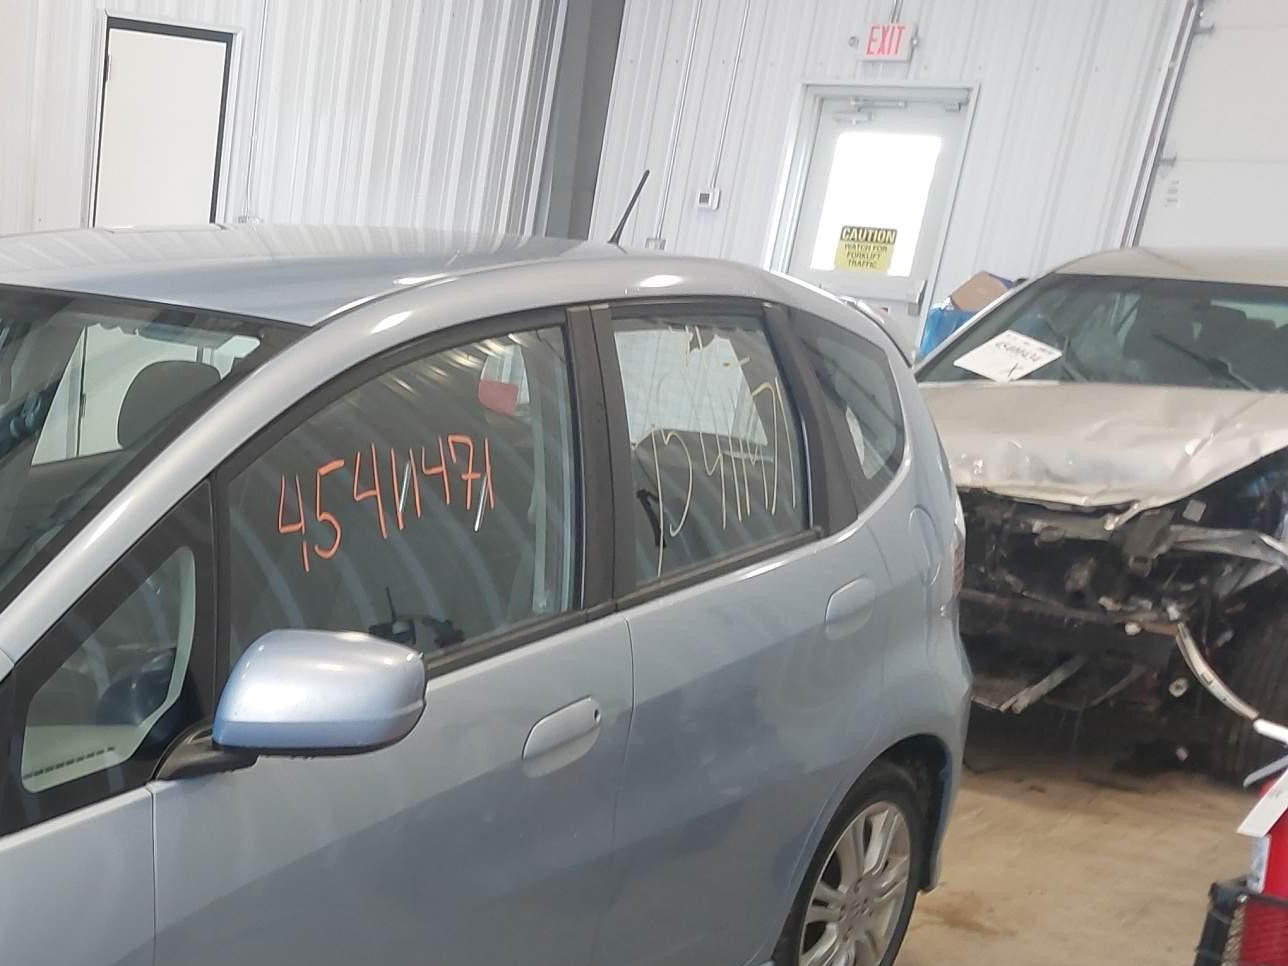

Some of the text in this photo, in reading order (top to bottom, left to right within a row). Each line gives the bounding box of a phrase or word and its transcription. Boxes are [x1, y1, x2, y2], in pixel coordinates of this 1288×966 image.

[866, 25, 905, 55] EXIT
[842, 227, 897, 244] CAUTION
[846, 250, 881, 260] FORKLIFT
[848, 259, 878, 269] TRAFFIC
[278, 433, 495, 573] 45411471
